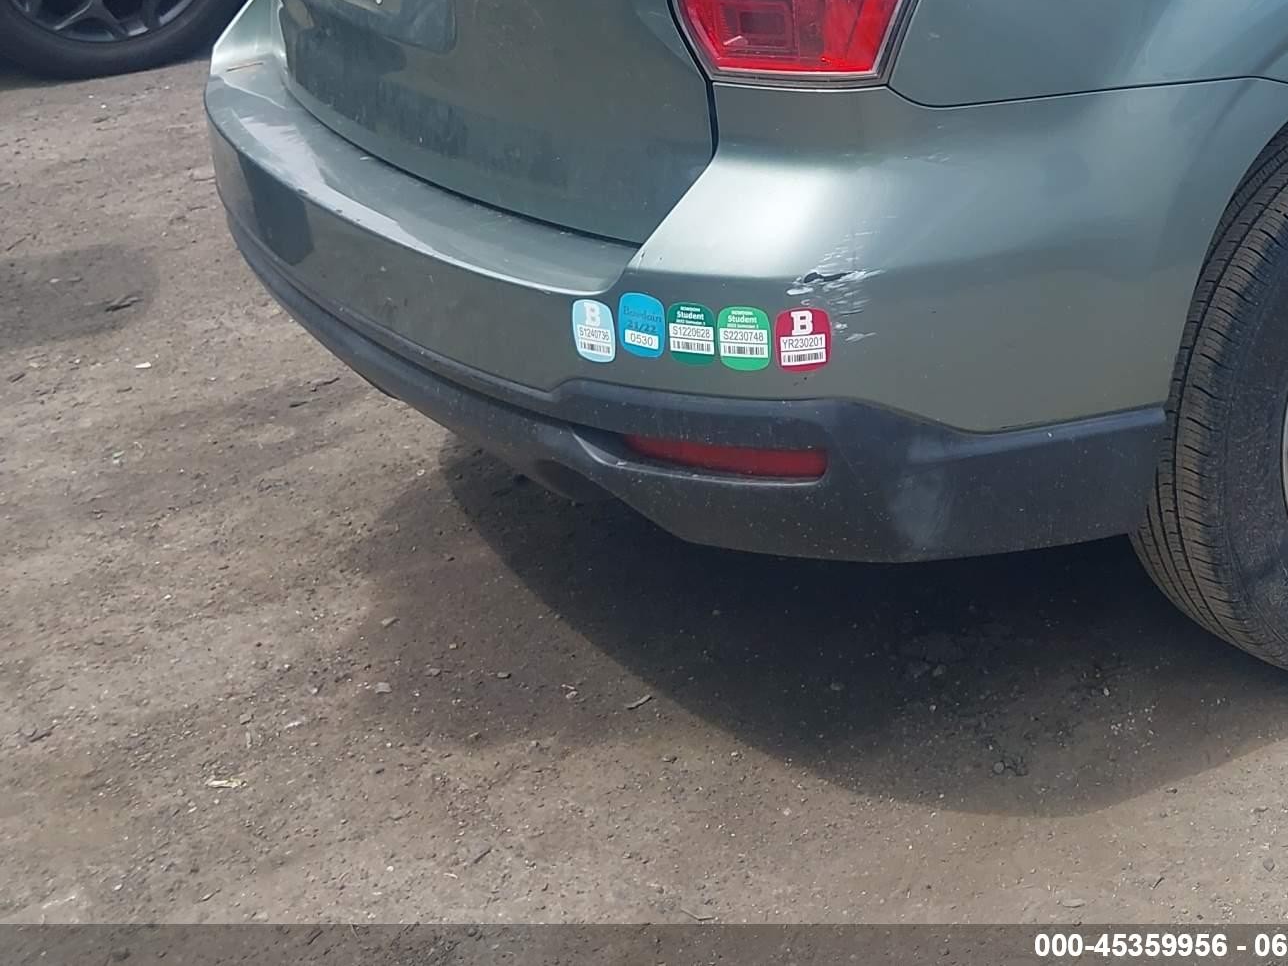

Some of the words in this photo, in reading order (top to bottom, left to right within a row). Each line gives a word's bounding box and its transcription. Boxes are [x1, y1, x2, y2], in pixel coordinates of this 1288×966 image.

[583, 302, 602, 327] B
[676, 311, 705, 321] Student
[727, 314, 757, 324] Student
[790, 310, 813, 336] B
[630, 332, 654, 347] 0530
[723, 330, 764, 342] S2230748
[782, 336, 823, 350] YR230201
